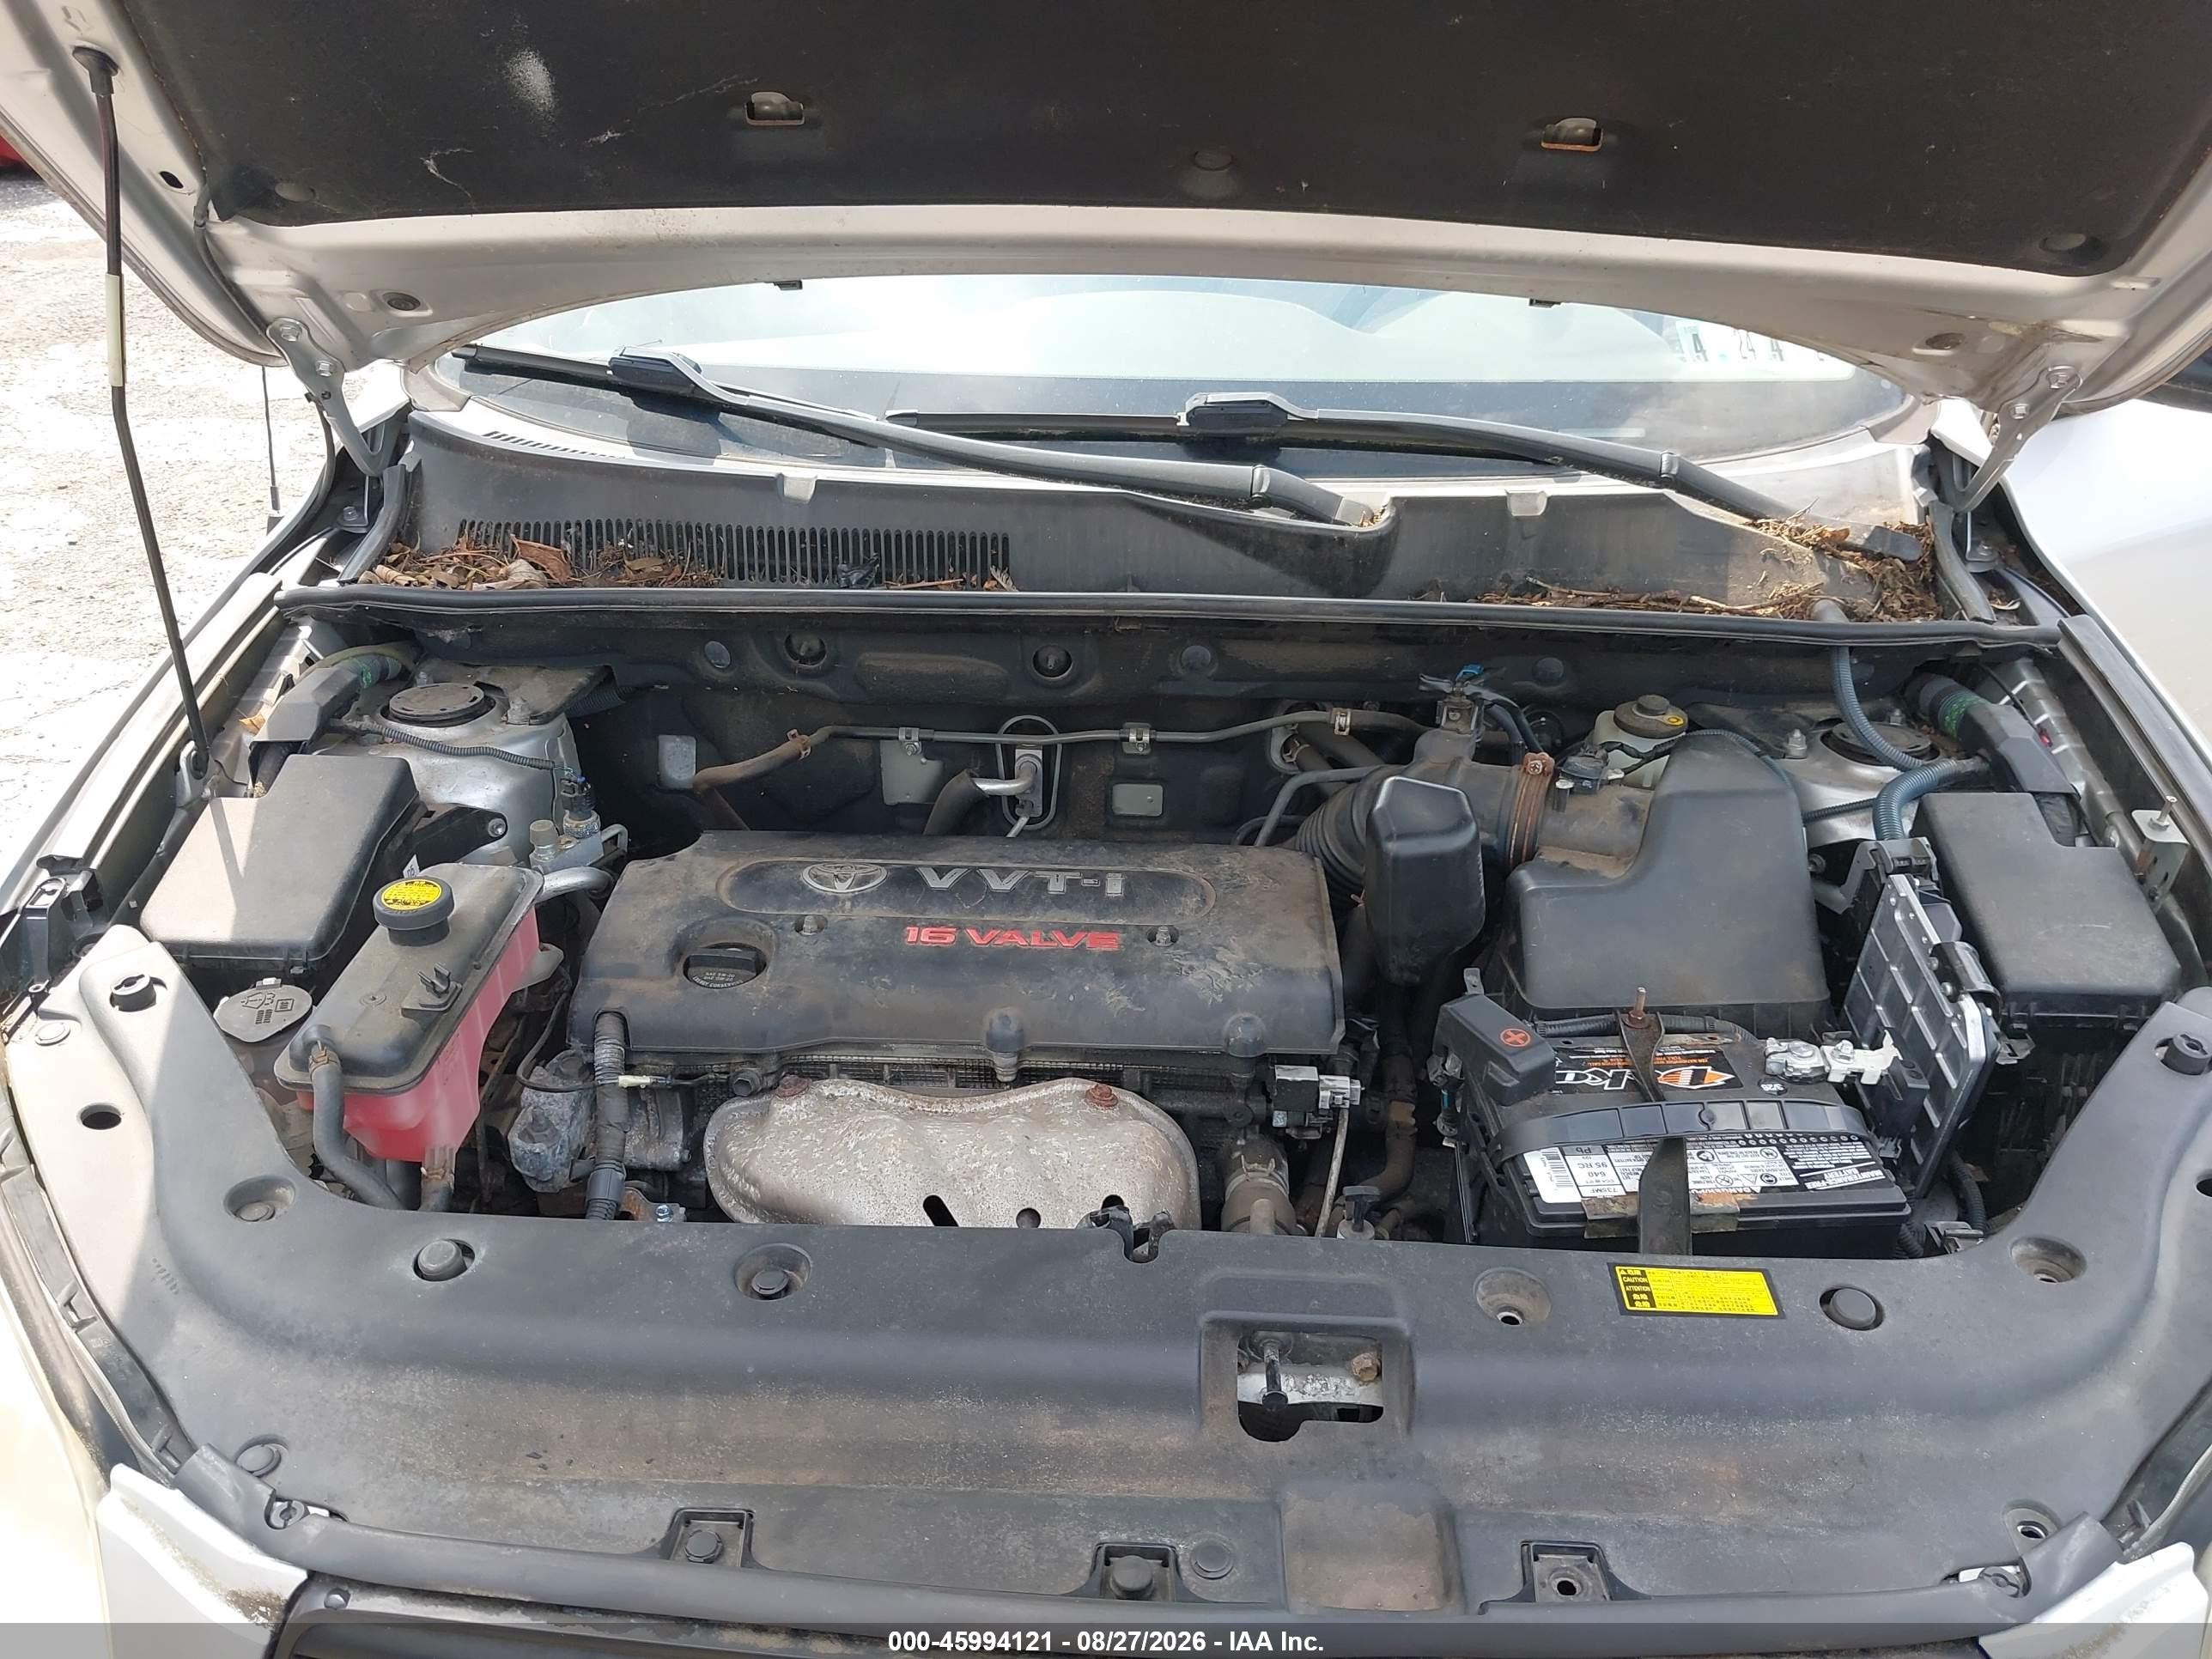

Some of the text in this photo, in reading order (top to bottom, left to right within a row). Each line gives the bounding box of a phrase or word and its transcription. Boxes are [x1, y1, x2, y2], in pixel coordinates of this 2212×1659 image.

[906, 927, 1121, 950] 16 VALVE
[1574, 1146, 1592, 1155] Pb
